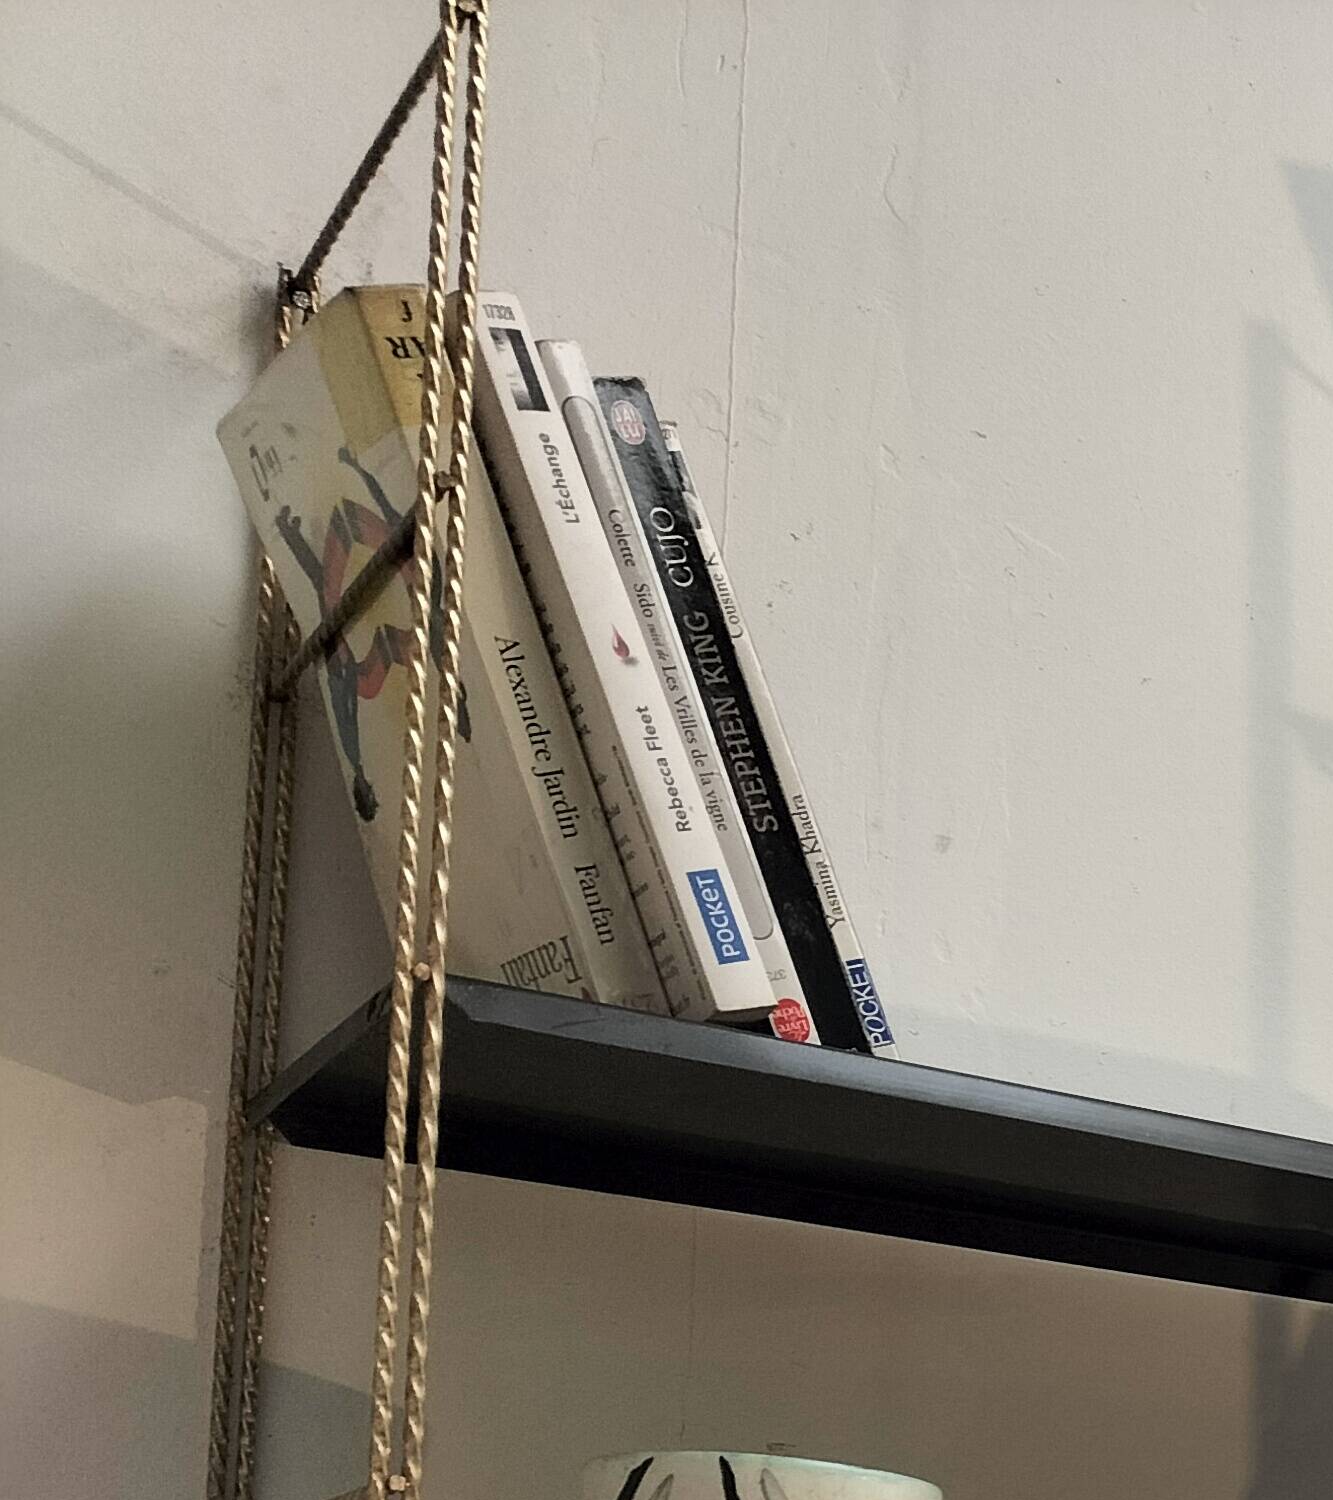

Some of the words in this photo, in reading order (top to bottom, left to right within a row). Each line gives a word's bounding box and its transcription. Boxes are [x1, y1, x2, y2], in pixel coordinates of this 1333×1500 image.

[385, 336, 425, 359] AR
[538, 432, 581, 524] L'Échange
[607, 508, 637, 568] Colette
[650, 506, 695, 588] CUJO
[633, 582, 654, 619] Sido
[713, 572, 745, 638] Cousine
[662, 659, 680, 692] Les
[683, 611, 730, 687] KING
[635, 705, 663, 752] Fleet
[674, 694, 699, 746] Vrilles
[690, 748, 709, 769] de
[699, 770, 714, 787] la
[711, 695, 778, 834] STEPHEN
[494, 635, 552, 762] Alexandre
[531, 764, 581, 840] Jardin
[574, 863, 615, 945] Fanfan
[656, 756, 692, 833] Rebecca
[705, 788, 728, 832] vigne
[791, 794, 822, 855] Khadra
[815, 860, 846, 929] Yasmina
